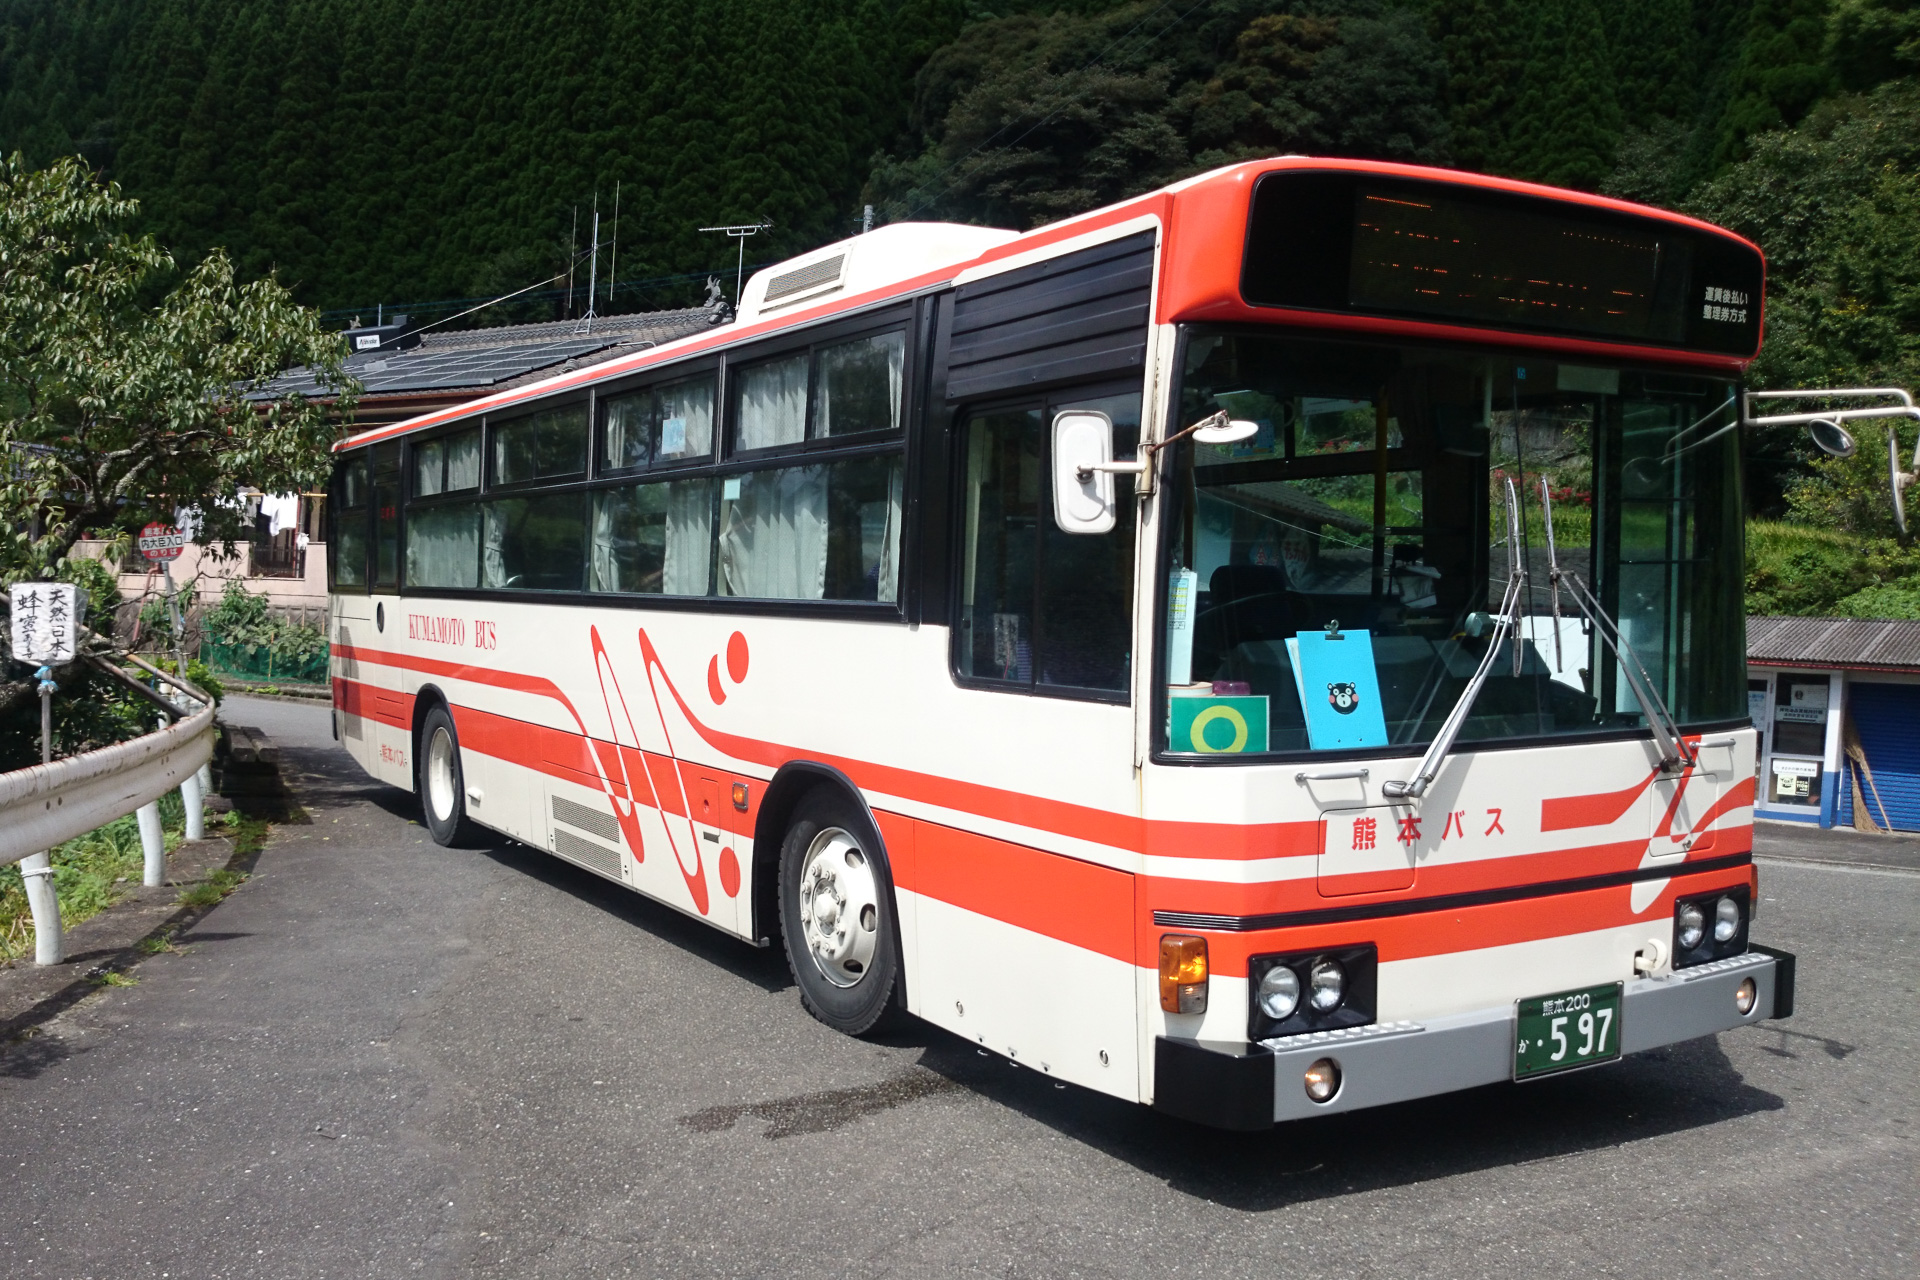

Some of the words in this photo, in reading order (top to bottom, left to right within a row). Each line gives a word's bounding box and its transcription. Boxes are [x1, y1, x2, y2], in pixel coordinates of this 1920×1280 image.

[1705, 286, 1748, 305] 運賃後払い
[1703, 304, 1747, 323] 整理券方式
[141, 536, 183, 549] 内大臣入口
[150, 548, 178, 557] のりば
[46, 588, 71, 658] 天然日本
[408, 613, 465, 647] KUMAMOTO
[475, 620, 497, 651] BUS
[1351, 807, 1505, 851] 熊本バス
